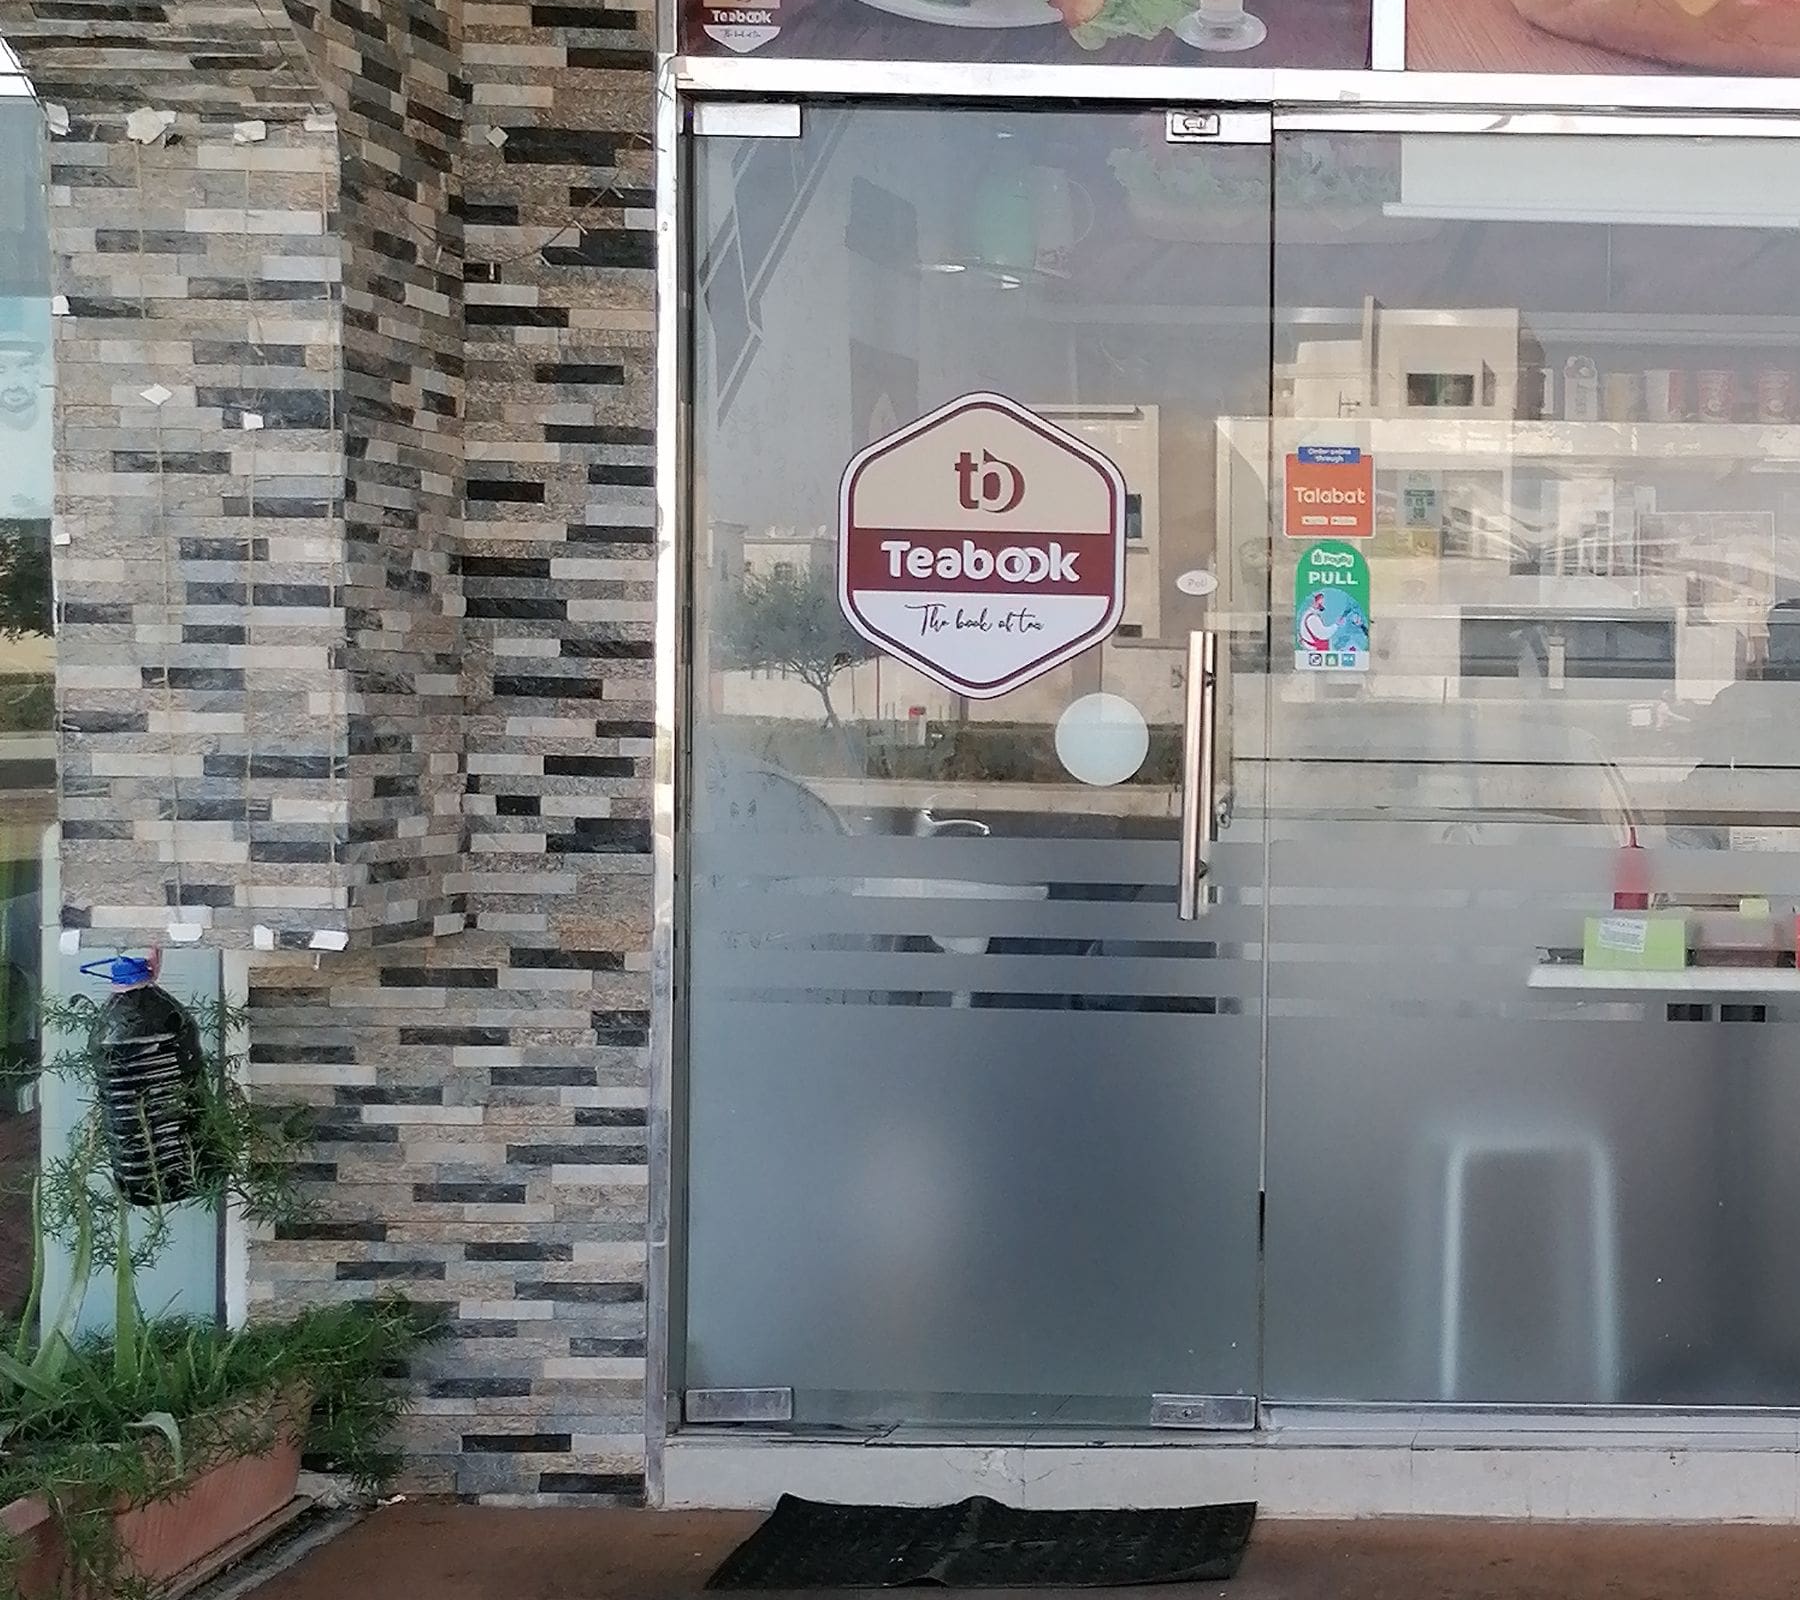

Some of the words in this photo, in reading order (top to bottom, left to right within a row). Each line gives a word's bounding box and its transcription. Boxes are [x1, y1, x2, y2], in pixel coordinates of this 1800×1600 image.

[711, 9, 772, 24] Teabook
[1292, 486, 1367, 504] Talabat
[880, 539, 1081, 584] Teabook
[1308, 571, 1359, 585] PULL
